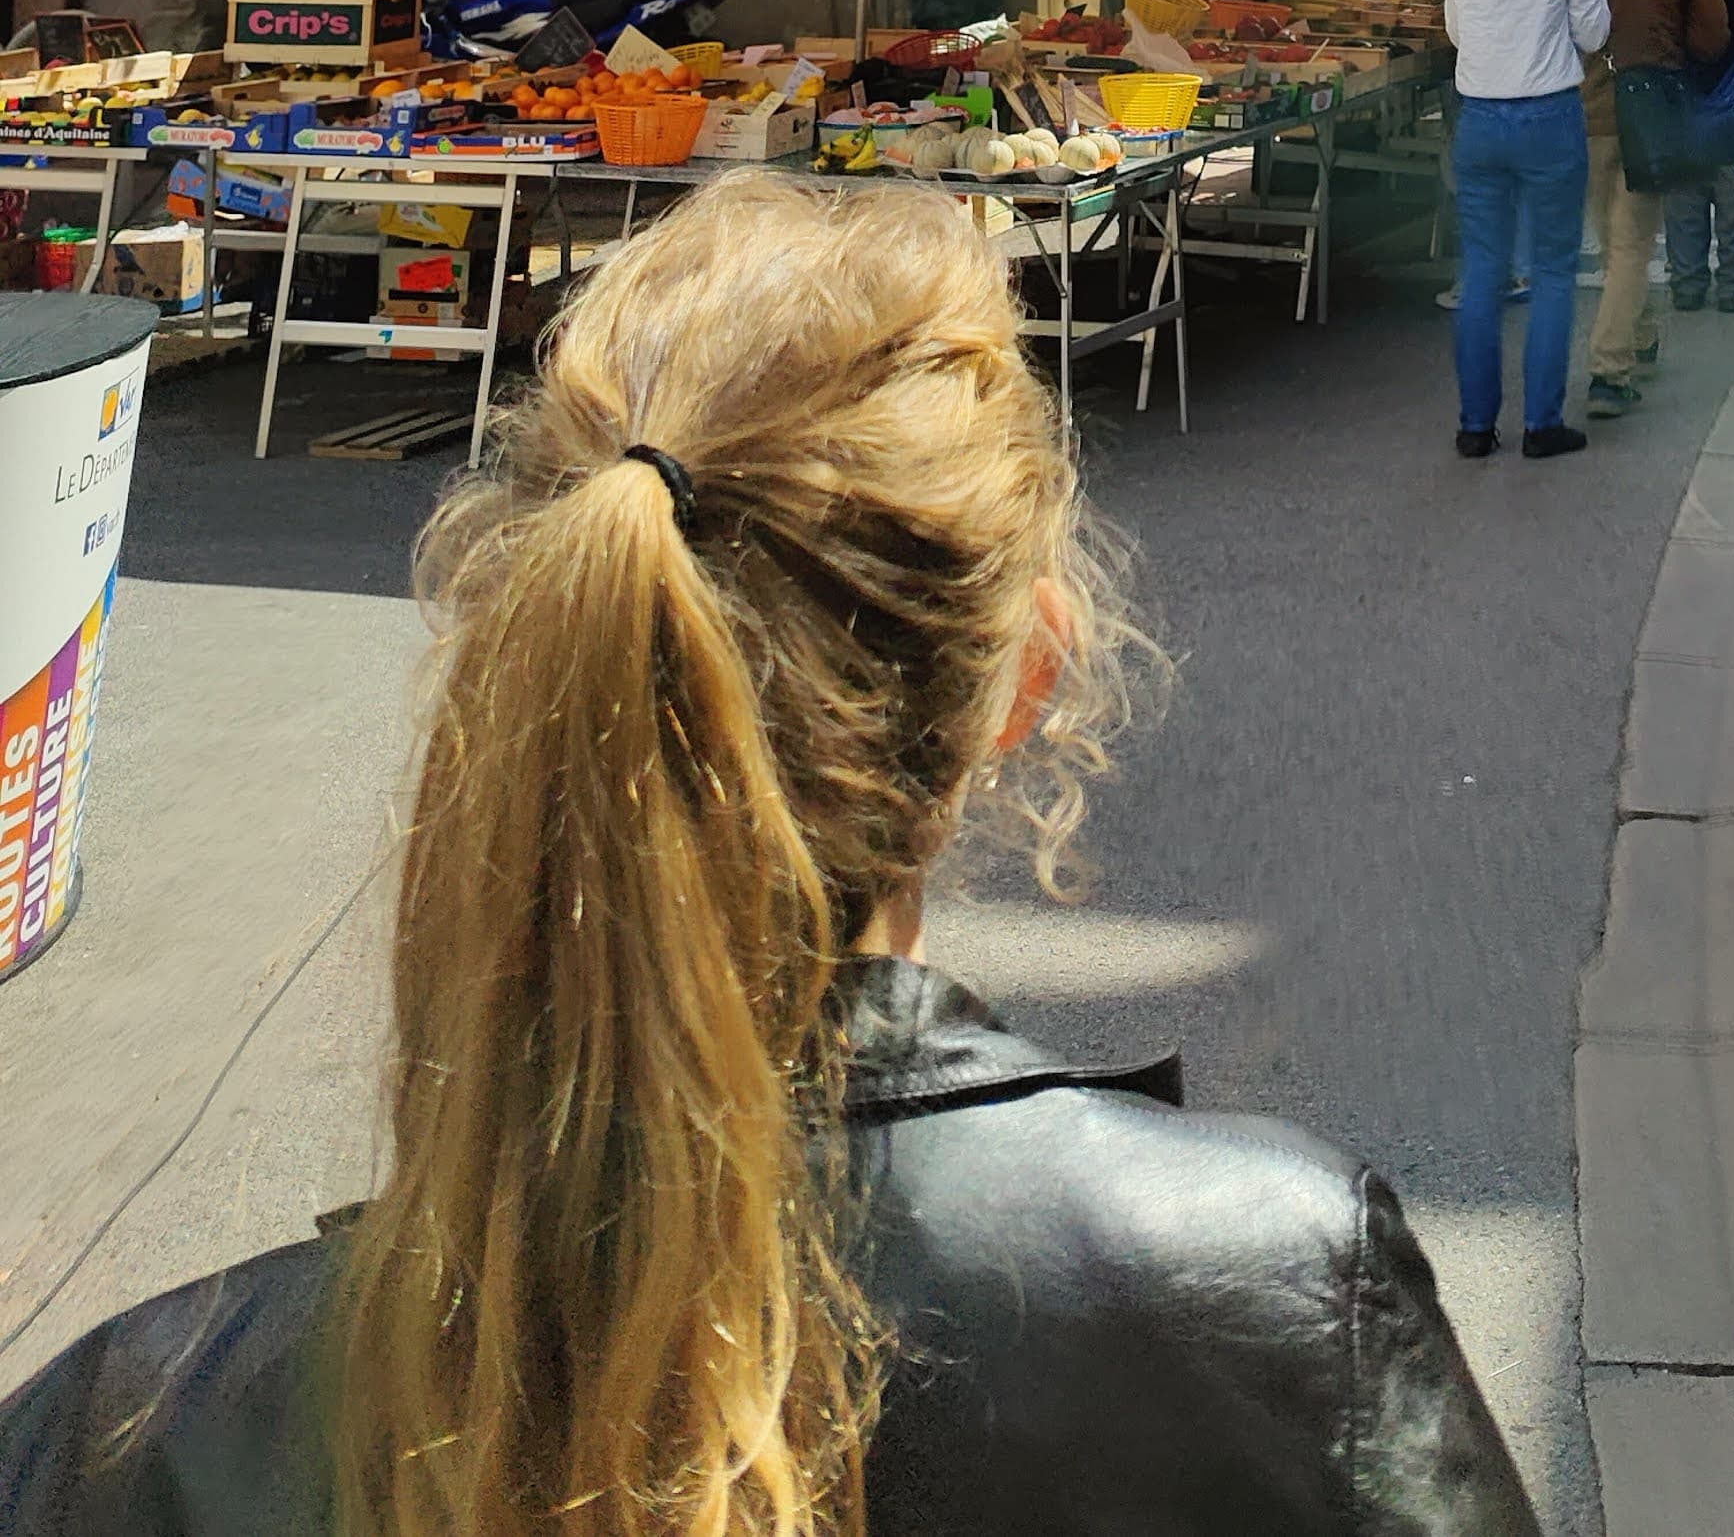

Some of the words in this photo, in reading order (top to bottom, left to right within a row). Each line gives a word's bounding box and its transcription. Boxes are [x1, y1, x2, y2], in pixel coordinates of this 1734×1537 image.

[248, 8, 350, 41] Crip's
[34, 125, 111, 141] d'Aquitaine
[20, 687, 74, 943] CULTURE
[48, 636, 98, 915] TOURISME
